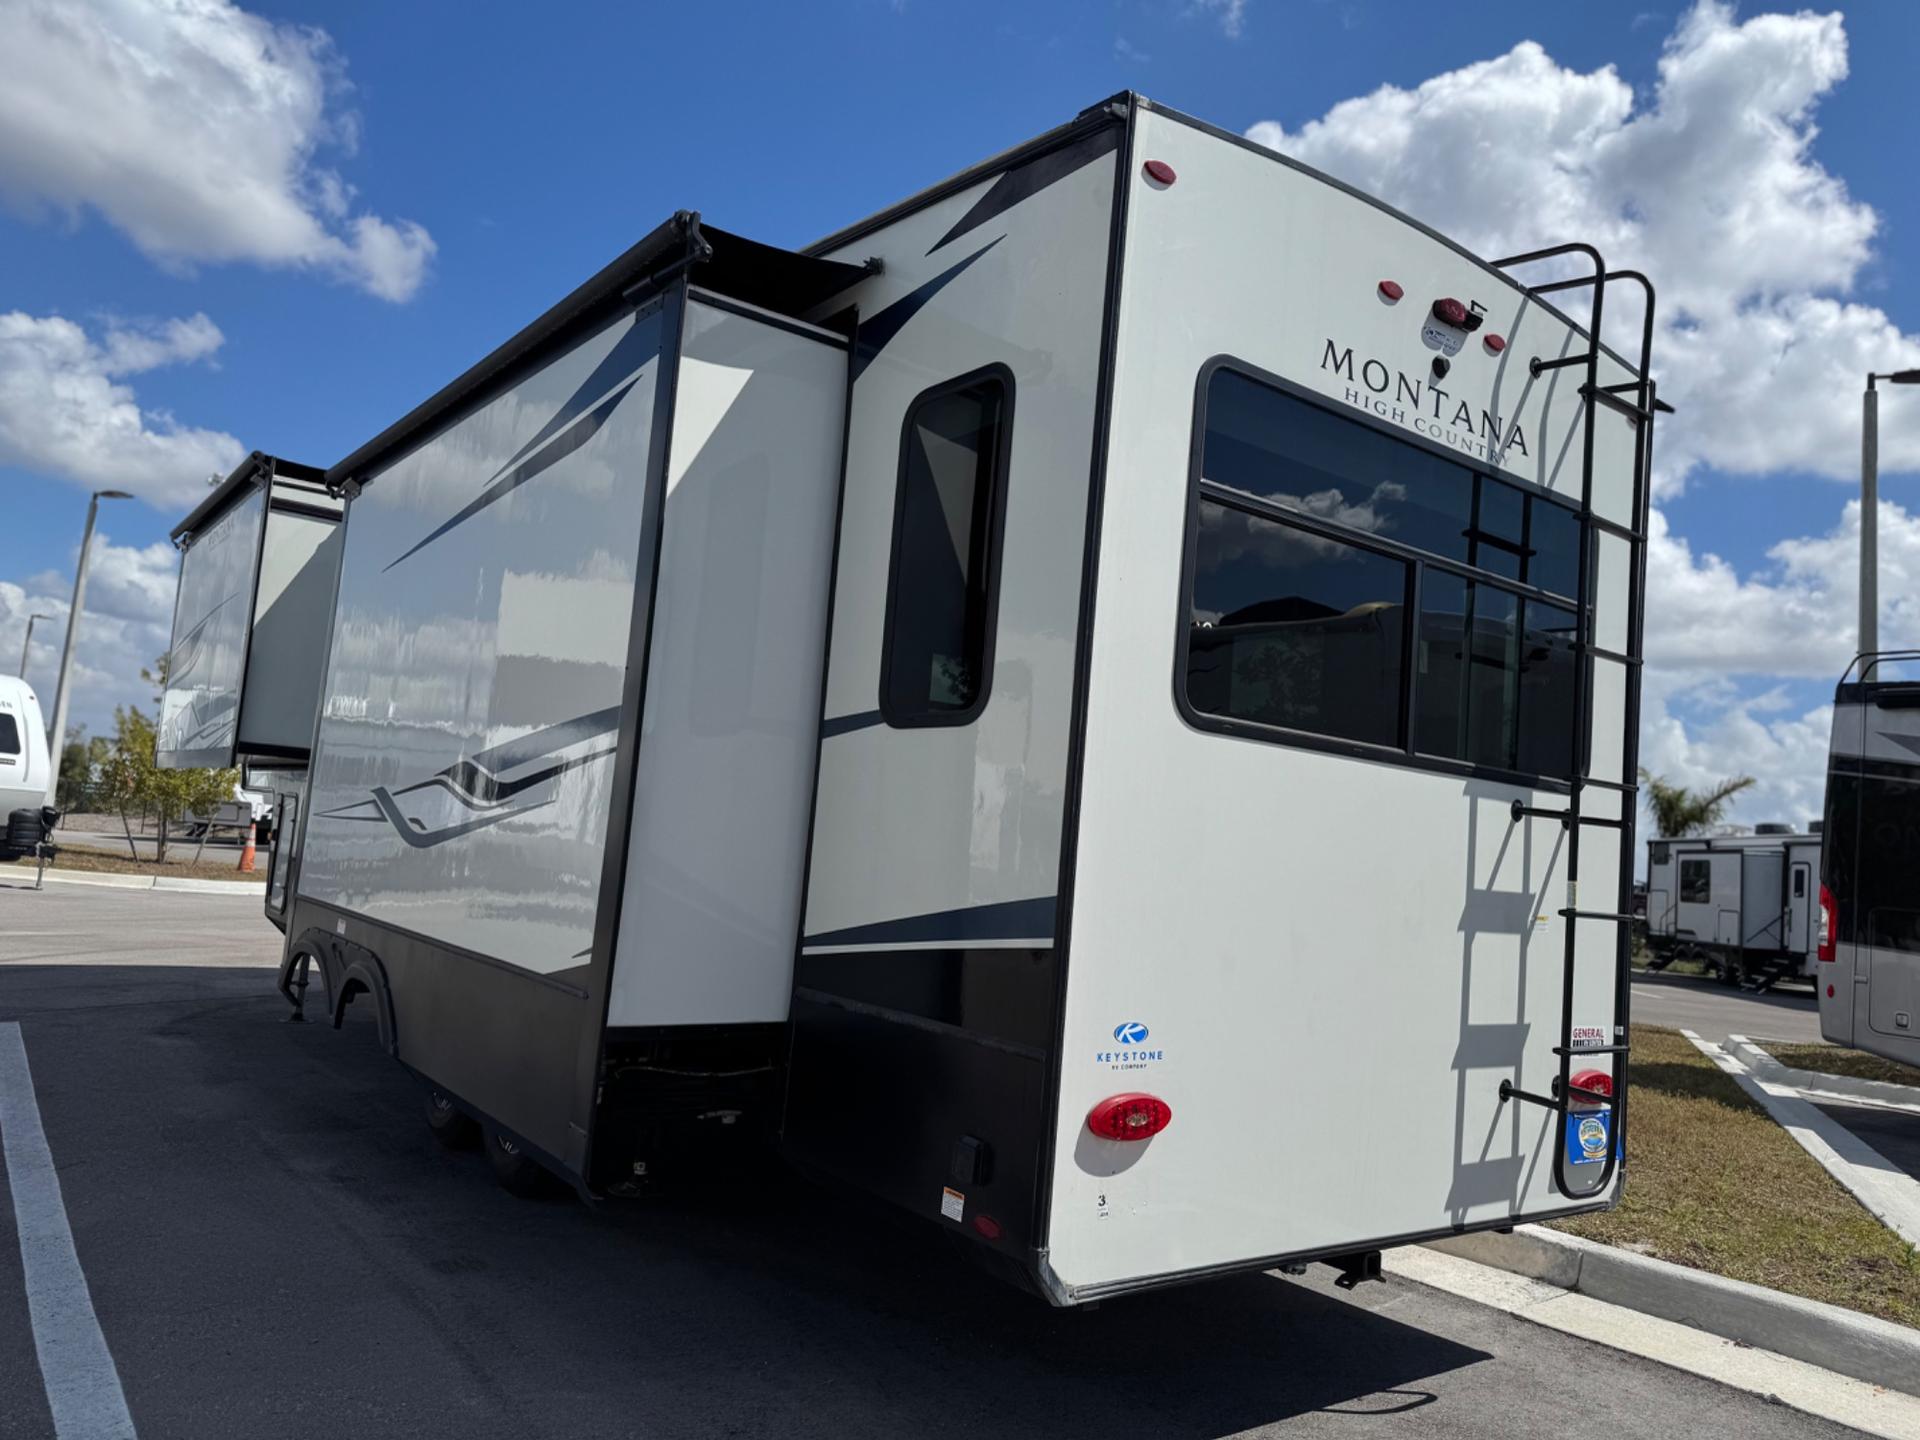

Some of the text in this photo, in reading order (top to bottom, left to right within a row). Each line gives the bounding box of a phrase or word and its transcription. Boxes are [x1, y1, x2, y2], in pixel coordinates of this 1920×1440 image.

[1320, 338, 1529, 457] MONTANA
[1344, 387, 1510, 468] HIGH COUNTRY
[1573, 1027, 1604, 1039] GENERAL
[1096, 1050, 1163, 1063] KEYSTONE
[1098, 1194, 1106, 1207] 3
